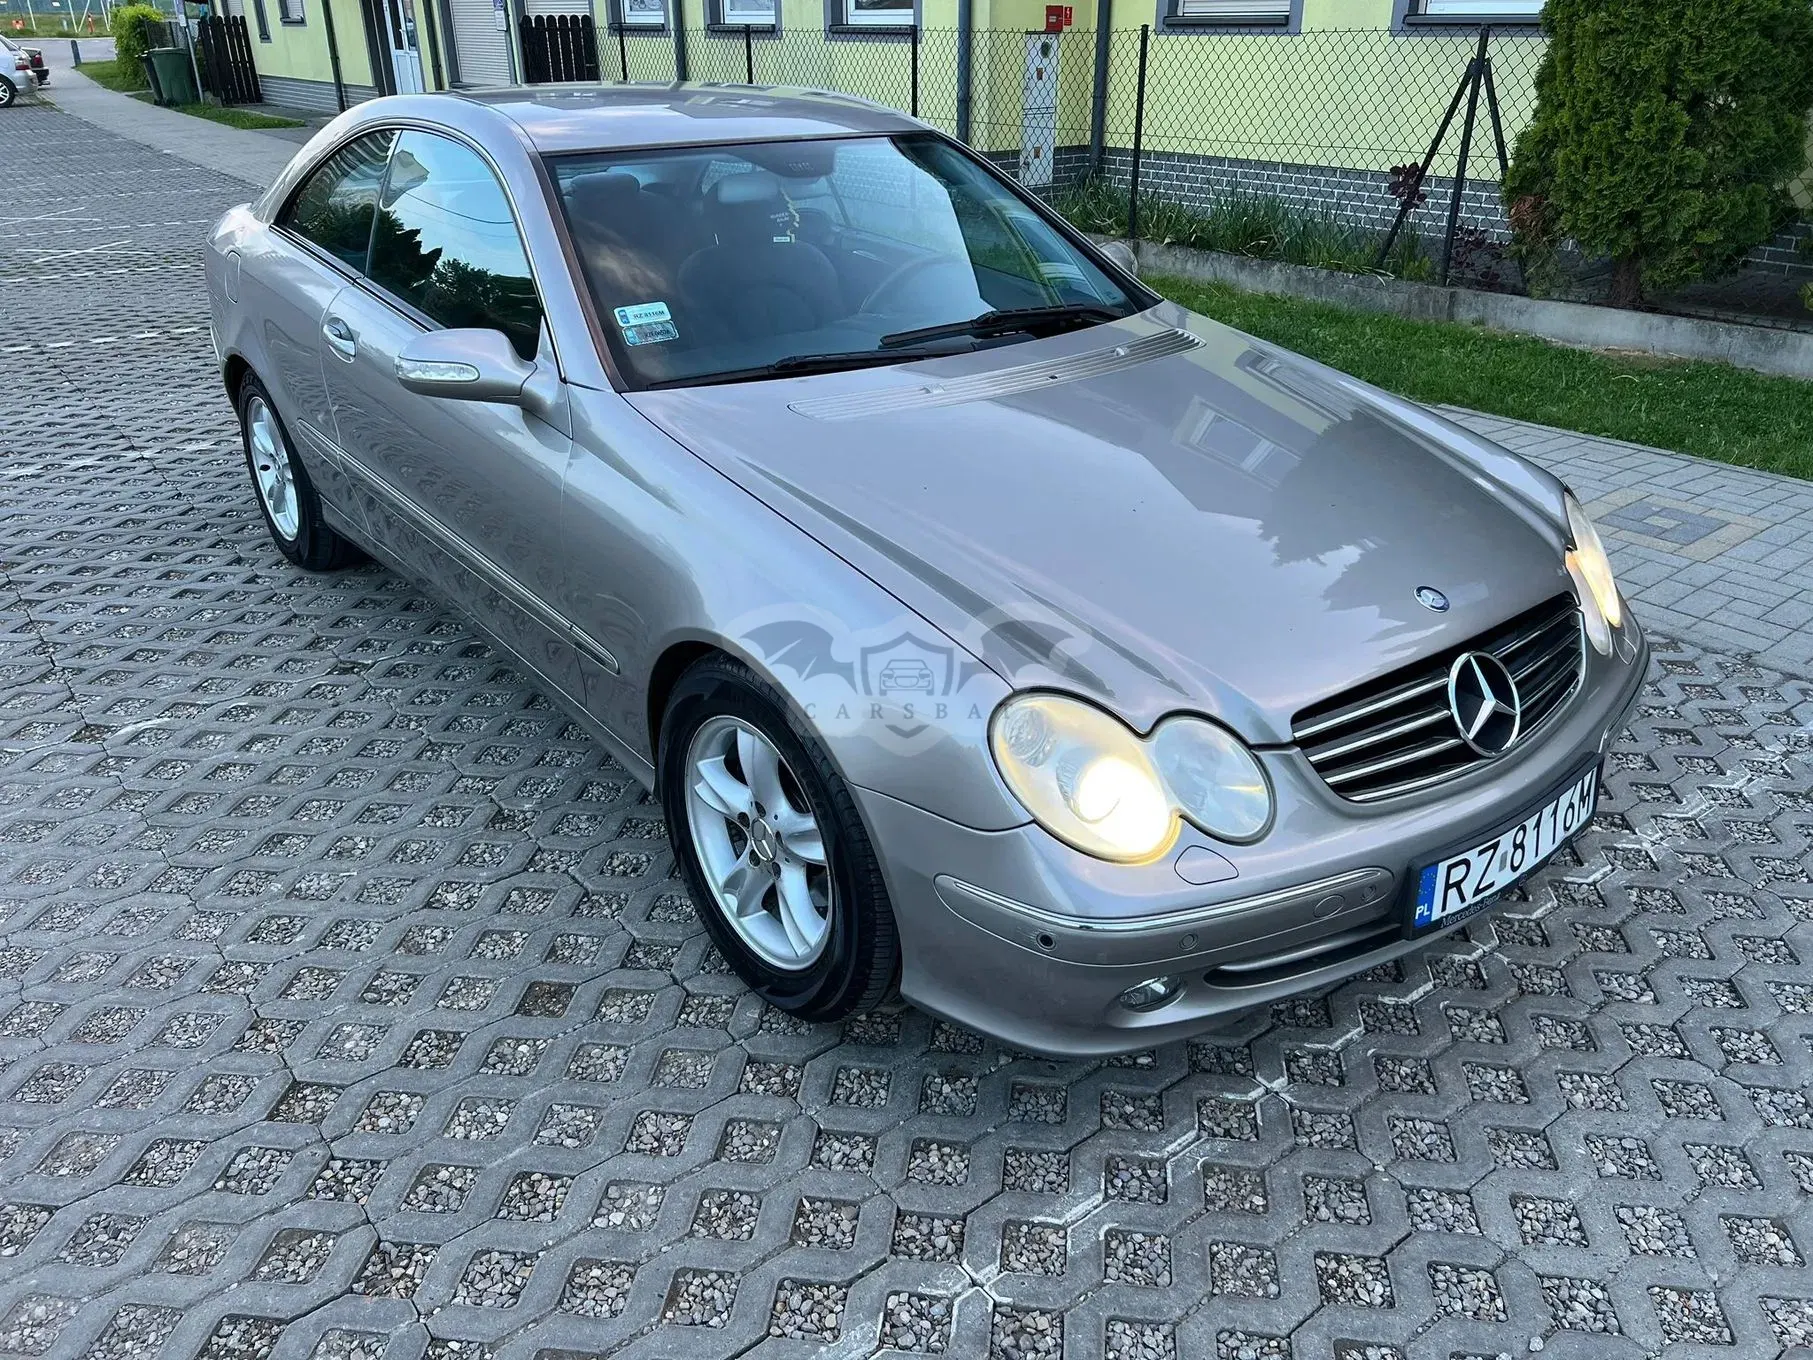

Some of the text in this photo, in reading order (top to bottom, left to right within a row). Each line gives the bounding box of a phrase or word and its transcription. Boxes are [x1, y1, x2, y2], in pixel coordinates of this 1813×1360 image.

[1441, 769, 1596, 913] RZ 8116M
[1415, 905, 1431, 920] PL
